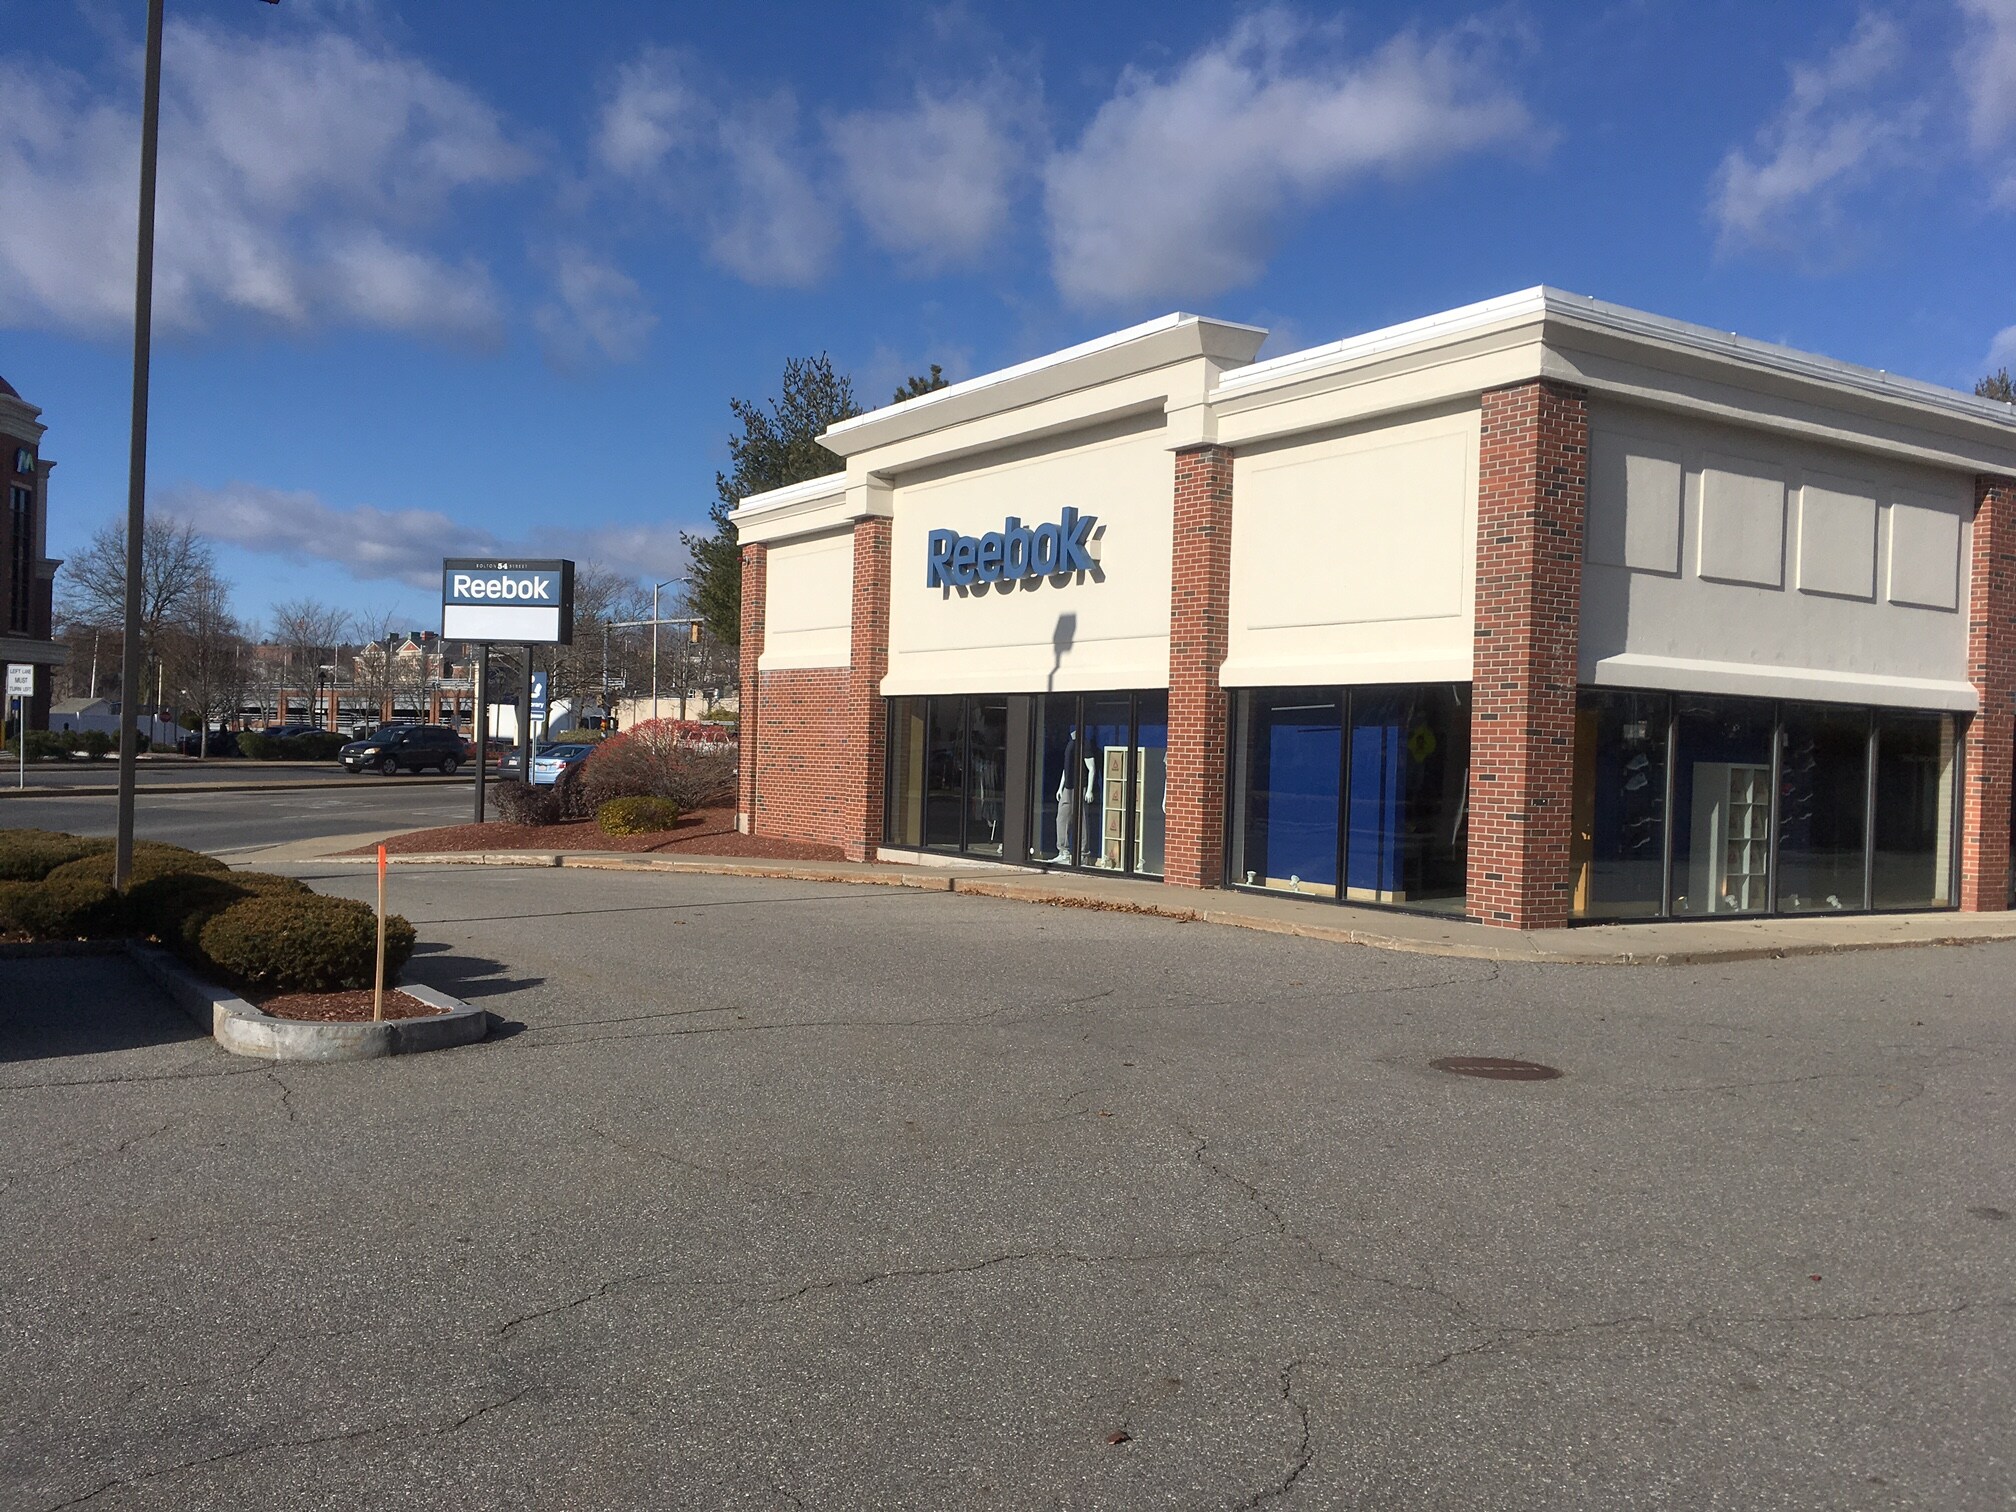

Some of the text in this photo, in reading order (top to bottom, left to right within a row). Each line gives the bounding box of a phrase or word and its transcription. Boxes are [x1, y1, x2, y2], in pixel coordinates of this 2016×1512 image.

[927, 506, 1098, 588] Reebok
[497, 562, 508, 570] 54
[453, 574, 550, 599] Reebok
